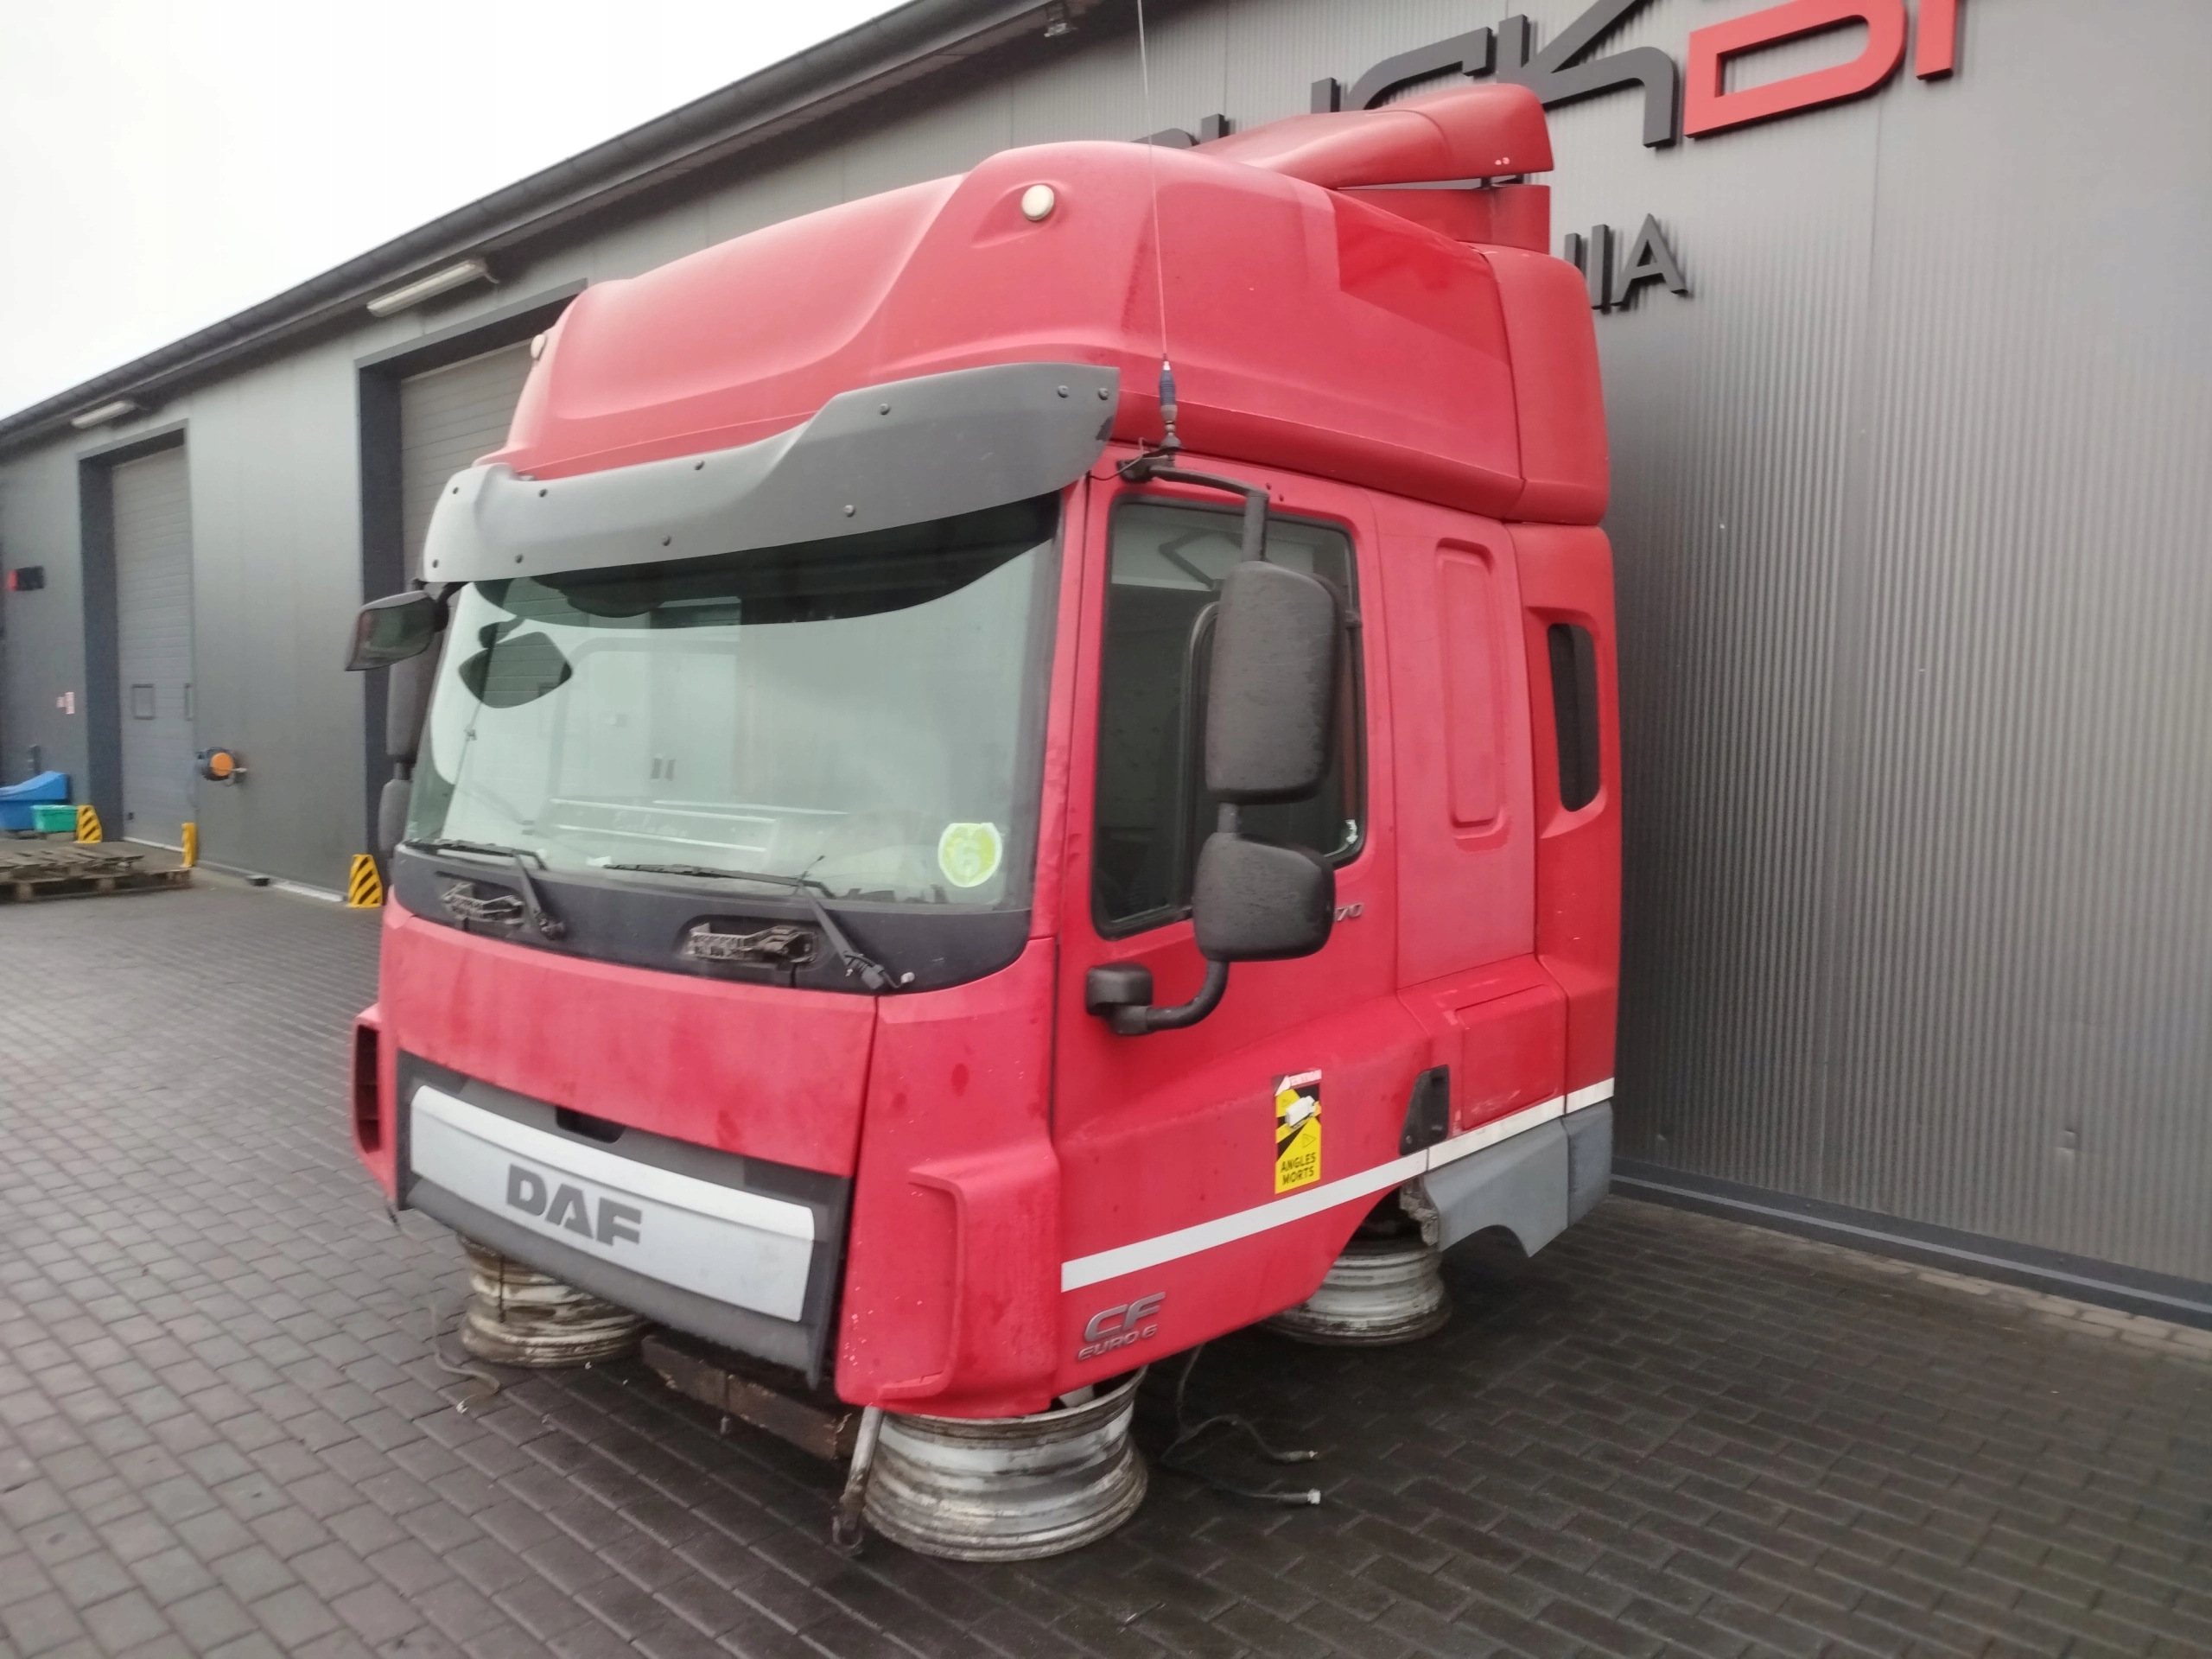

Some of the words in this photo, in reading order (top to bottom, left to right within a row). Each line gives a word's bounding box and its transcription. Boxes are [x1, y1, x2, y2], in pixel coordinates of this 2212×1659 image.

[1334, 903, 1364, 922] 70
[1281, 1152, 1316, 1173] ANGLES
[1281, 1166, 1315, 1186] MORTS
[506, 1164, 643, 1246] DAF
[1084, 1291, 1166, 1342] CF
[1078, 1331, 1140, 1361] EURO
[1142, 1324, 1158, 1338] 6
